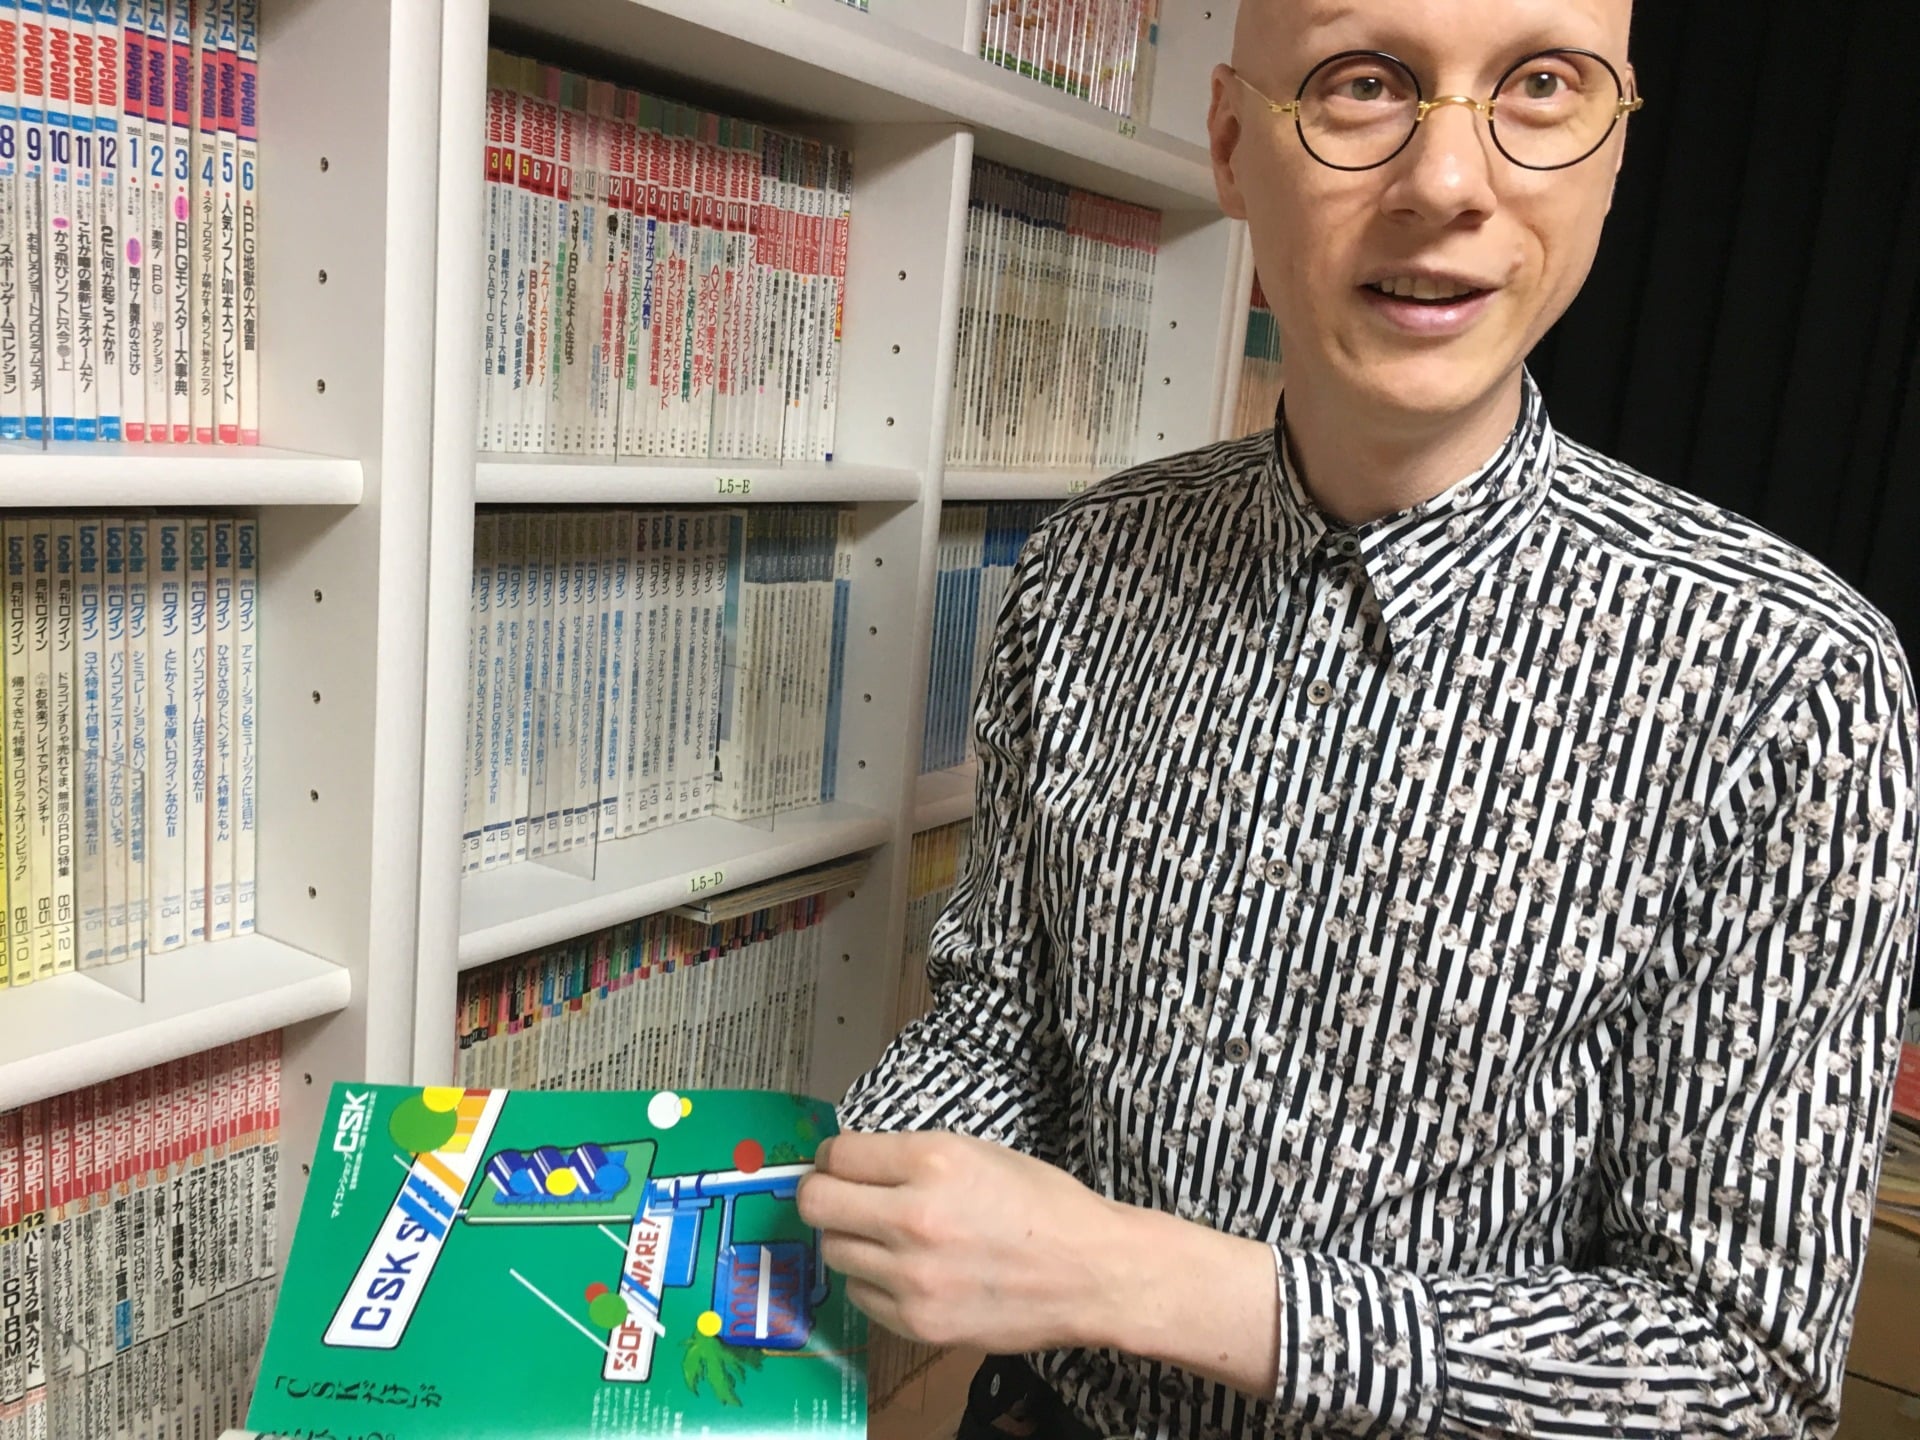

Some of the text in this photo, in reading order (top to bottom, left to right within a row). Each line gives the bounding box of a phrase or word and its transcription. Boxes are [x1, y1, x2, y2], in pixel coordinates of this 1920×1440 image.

[0, 125, 15, 159] 8
[27, 127, 41, 161] 9
[49, 130, 70, 164] 10
[75, 135, 91, 169] 11
[98, 136, 116, 169] 12
[129, 137, 138, 168] 1
[151, 145, 164, 177] 2
[175, 149, 188, 180] 3
[202, 156, 213, 188] 4
[222, 152, 233, 183] 5
[242, 161, 254, 191] 6
[492, 153, 498, 169] 3
[505, 153, 512, 170] 4
[533, 163, 540, 180] 6
[561, 169, 568, 187] 8
[586, 171, 596, 190] 10
[625, 179, 630, 197] 1
[649, 187, 656, 204] 3
[659, 193, 666, 211] 4
[684, 194, 689, 210] 6
[706, 198, 711, 215] 8
[716, 202, 722, 219] 9
[740, 203, 748, 222] 11
[152, 265, 163, 294] RPG
[486, 254, 496, 321] GALACTIC
[175, 222, 188, 396] RPGモンスター大事典
[718, 479, 751, 494] L5-E
[10, 582, 24, 655] 月刊ログイン
[35, 579, 48, 651] 月刊ログイン
[58, 579, 71, 652] 月刊ログイン
[639, 801, 648, 811] 2
[665, 792, 673, 801] 4
[693, 787, 700, 797] 6
[517, 825, 526, 836] 6
[549, 819, 557, 830] 8
[576, 814, 586, 825] 10
[470, 839, 480, 850] 3
[487, 832, 495, 842] 4
[690, 871, 723, 892] L5-D
[38, 897, 50, 924] 85
[58, 894, 70, 950] 85 12
[15, 906, 28, 961] 85 10
[212, 1072, 227, 1128] BASIC
[231, 1065, 246, 1121] BASIC
[247, 1060, 263, 1115] BASIC
[134, 1098, 151, 1156] BASIC
[155, 1094, 170, 1151] BASIC
[173, 1087, 189, 1144] BASIC
[333, 1089, 370, 1153] CSK
[75, 1120, 92, 1179] BASIC
[115, 1106, 131, 1164] BASIC
[23, 1134, 43, 1194] BASIC
[51, 1127, 69, 1187] BASIC
[0, 1147, 19, 1207] BASIC
[118, 1180, 130, 1195] 4
[58, 1205, 65, 1221] 1
[79, 1197, 90, 1213] 2
[97, 1191, 109, 1206] 3
[1, 1225, 19, 1241] 11
[24, 1212, 45, 1228] 12
[350, 1251, 420, 1331] CSK
[613, 1216, 663, 1372] SOFWARE!
[730, 1257, 757, 1338] DONT
[3, 1277, 21, 1358] CD-ROM
